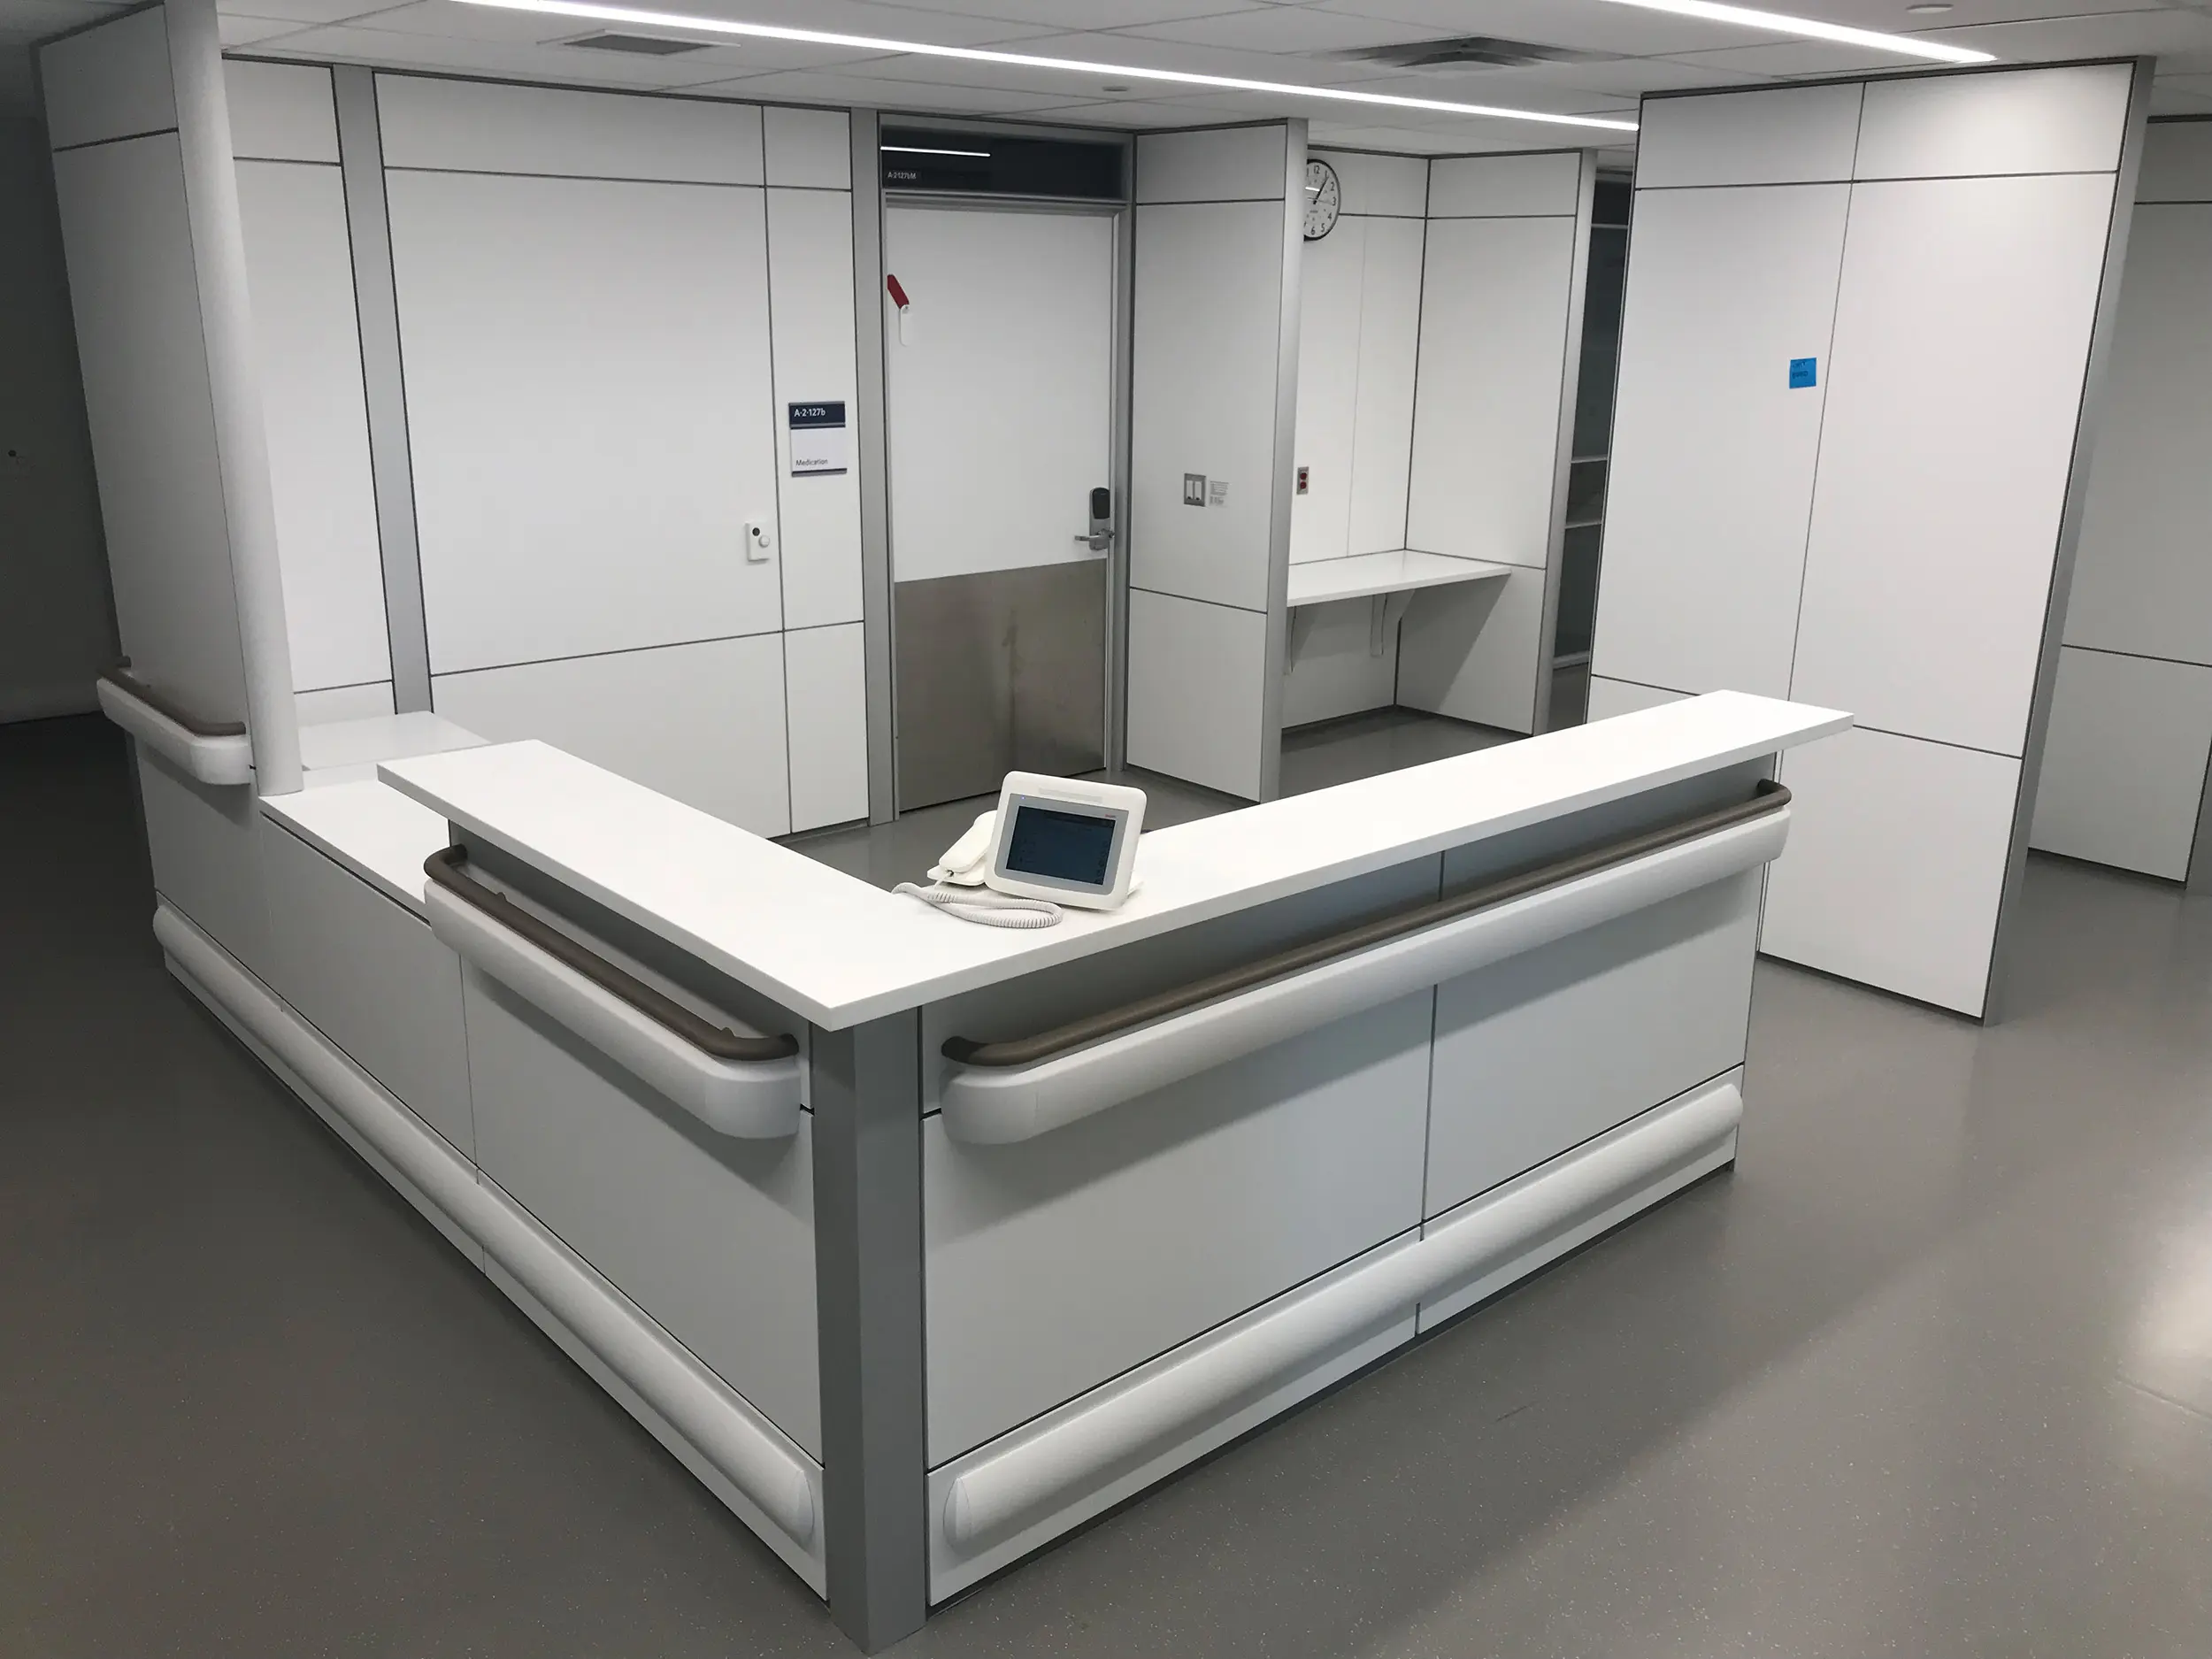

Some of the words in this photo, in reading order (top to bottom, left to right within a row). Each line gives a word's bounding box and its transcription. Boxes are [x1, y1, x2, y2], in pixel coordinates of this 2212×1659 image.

[1314, 165, 1320, 174] 12
[1330, 181, 1334, 191] 2
[1332, 196, 1336, 206] 3
[1327, 212, 1333, 221] 4
[1310, 227, 1316, 235] 6
[1321, 223, 1325, 232] 5
[795, 458, 828, 467] Medication
